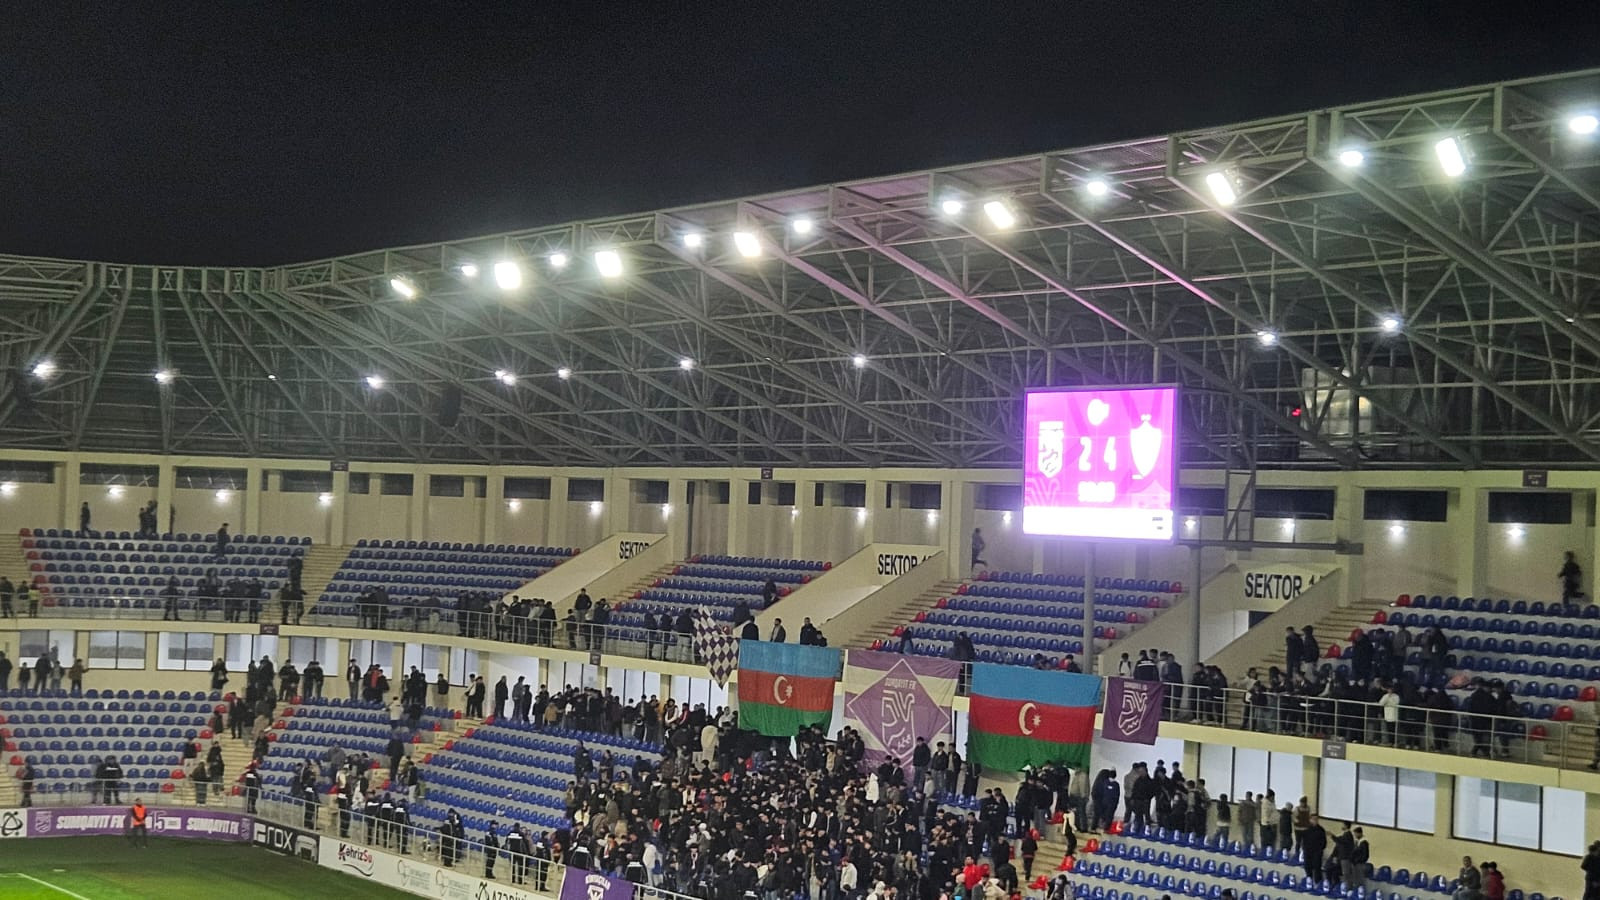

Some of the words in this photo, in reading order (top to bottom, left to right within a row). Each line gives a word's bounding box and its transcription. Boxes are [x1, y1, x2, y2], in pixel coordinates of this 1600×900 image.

[1078, 436, 1092, 472] 2
[1103, 436, 1117, 472] 4
[877, 553, 918, 576] SEKTOR
[1245, 572, 1302, 600] SEKTOR
[109, 815, 127, 829] FK
